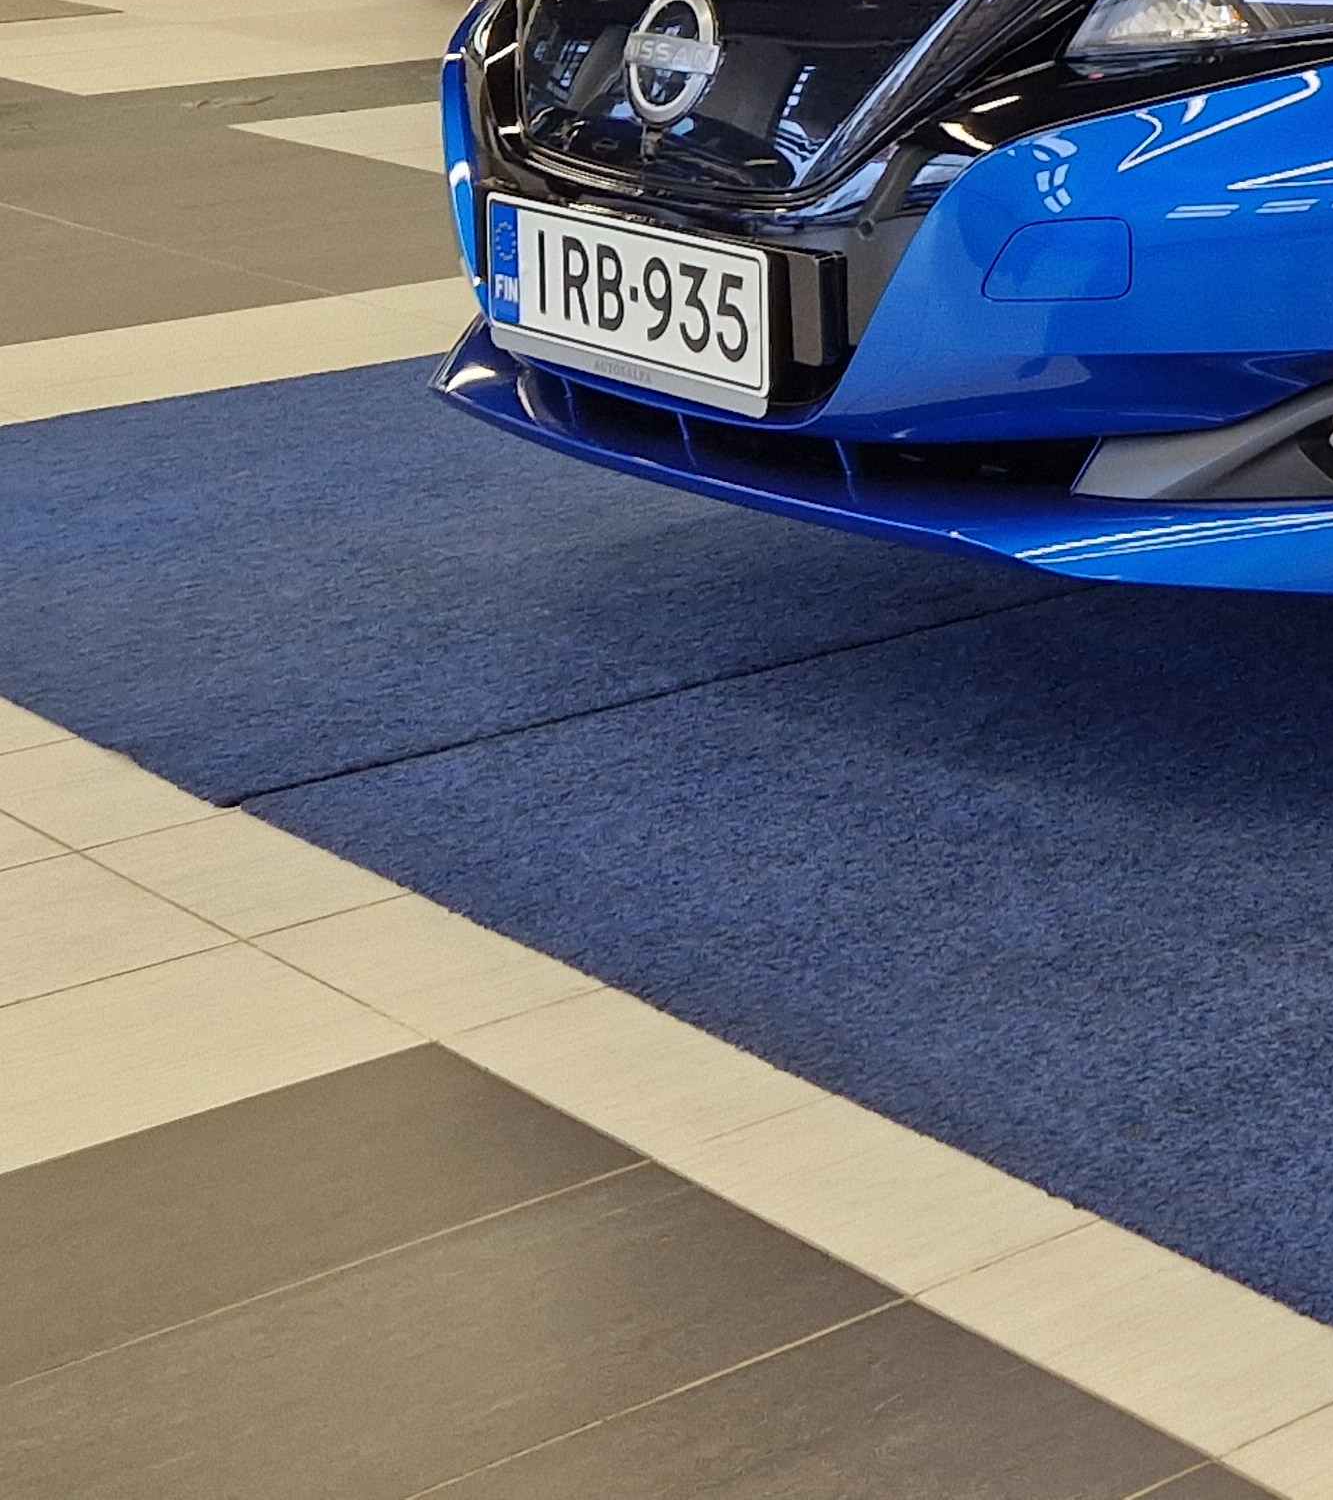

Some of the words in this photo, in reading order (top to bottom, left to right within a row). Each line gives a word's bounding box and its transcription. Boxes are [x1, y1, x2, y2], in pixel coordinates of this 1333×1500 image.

[625, 35, 714, 70] NISSAN
[495, 274, 518, 301] FIN
[537, 229, 749, 363] IRB-935
[594, 359, 652, 385] AUTOSALPA
